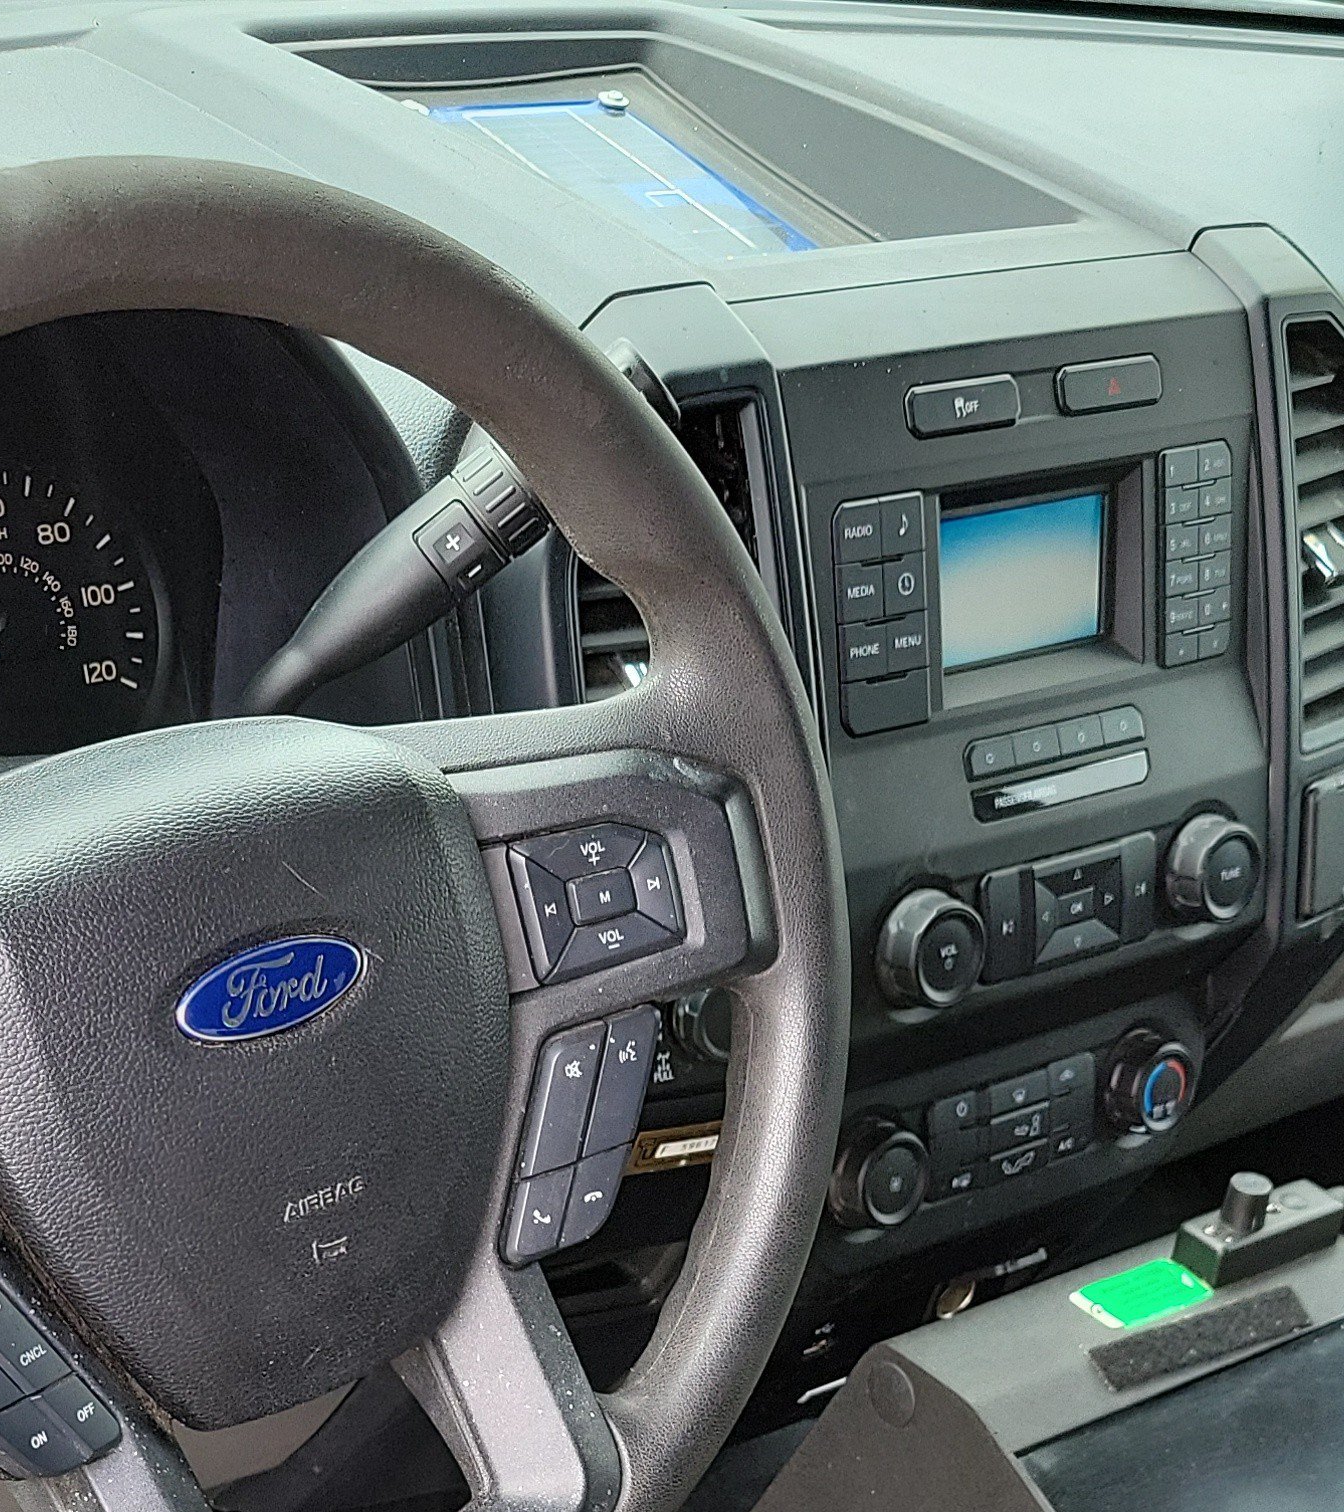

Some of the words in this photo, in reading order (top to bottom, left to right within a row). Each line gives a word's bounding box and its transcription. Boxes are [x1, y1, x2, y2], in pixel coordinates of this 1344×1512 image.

[36, 522, 71, 545] 80
[844, 524, 873, 540] RADIO
[20, 556, 40, 573] 120
[42, 571, 61, 592] 140
[80, 583, 115, 607] 100
[847, 584, 876, 600] MEDIA
[59, 596, 74, 618] 160
[67, 625, 78, 647] 180
[894, 634, 922, 649] MENU
[850, 643, 880, 660] PHONE
[83, 660, 117, 684] 120
[580, 841, 606, 856] VOL
[599, 890, 611, 904] M
[598, 928, 625, 944] VOL
[940, 944, 958, 958] VOL
[221, 951, 328, 1029] Ford
[283, 1175, 366, 1223] AIRBAG
[19, 1344, 48, 1367] CNCL
[76, 1401, 96, 1422] OFF
[30, 1430, 48, 1449] ON
